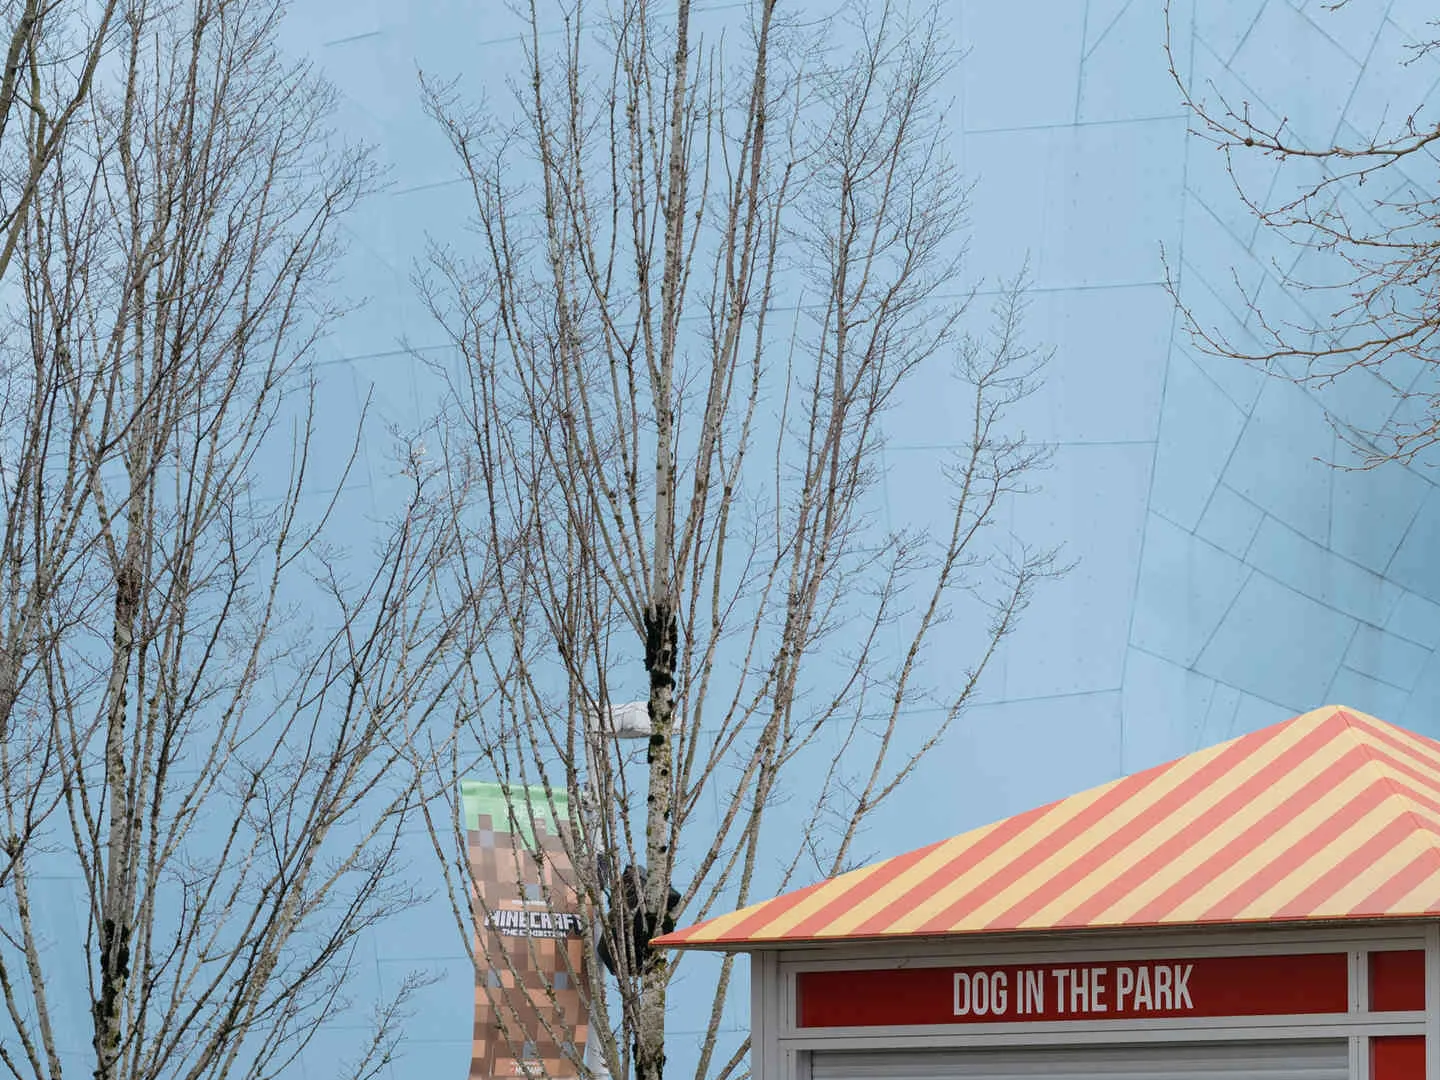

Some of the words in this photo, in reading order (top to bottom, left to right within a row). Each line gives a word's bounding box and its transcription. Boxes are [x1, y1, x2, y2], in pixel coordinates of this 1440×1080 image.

[519, 929, 567, 938] EHIBITIN
[953, 971, 1008, 1016] DOG
[1016, 970, 1044, 1015] IN
[1052, 967, 1108, 1013] THE
[1116, 964, 1194, 1012] PARK
